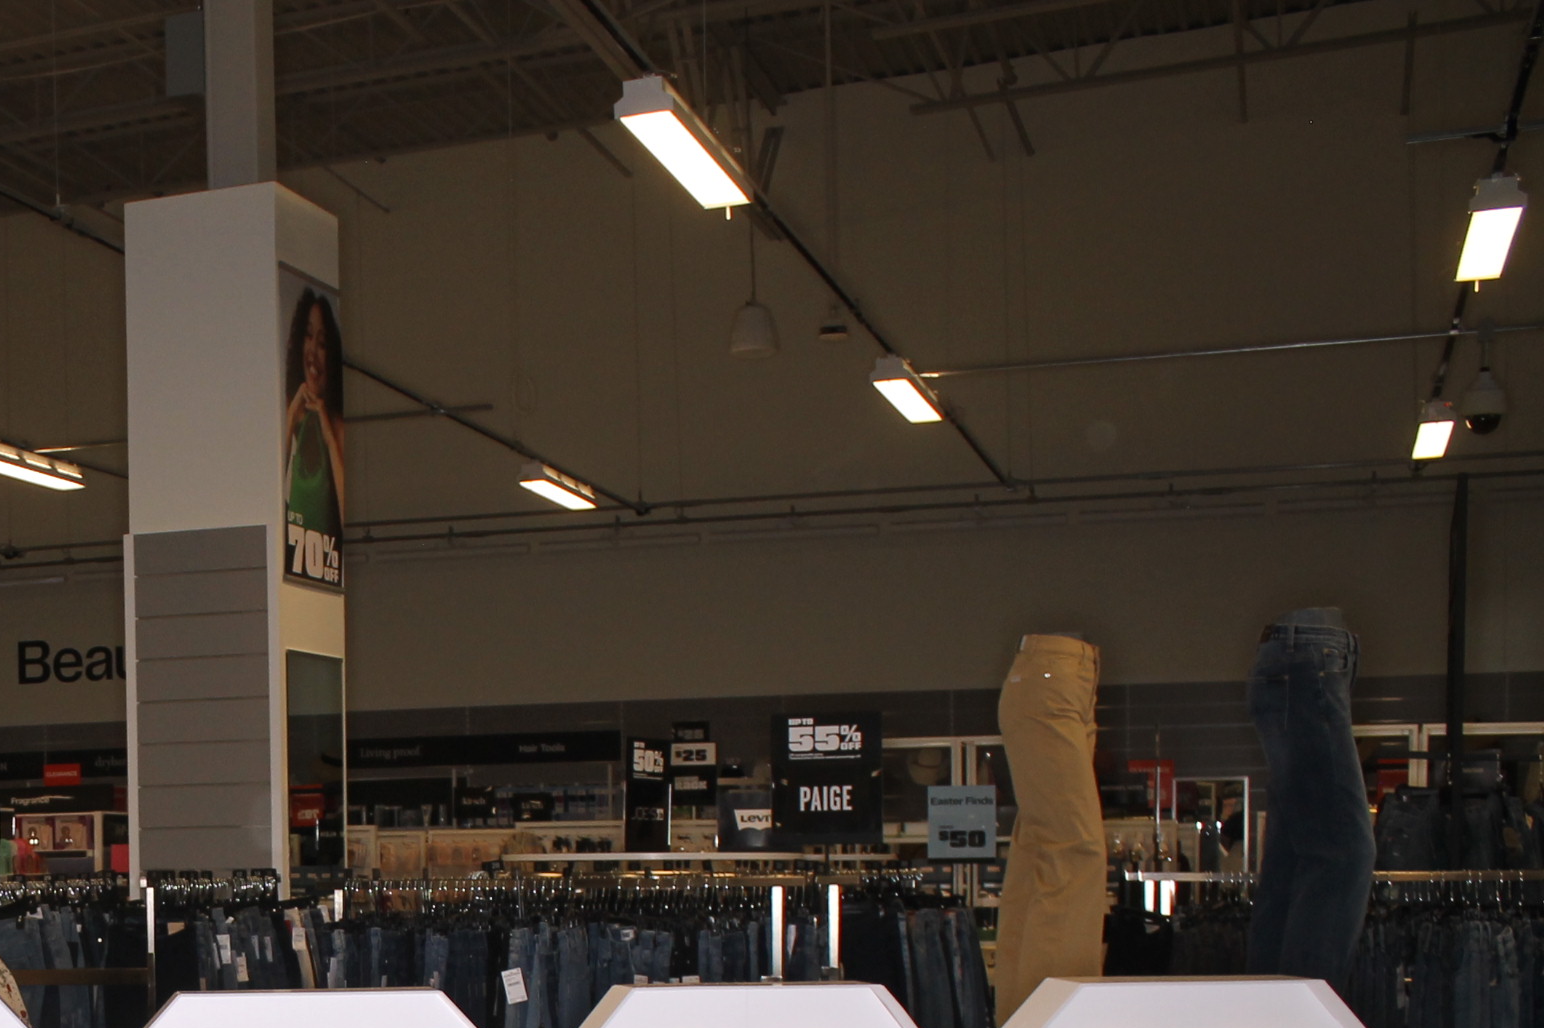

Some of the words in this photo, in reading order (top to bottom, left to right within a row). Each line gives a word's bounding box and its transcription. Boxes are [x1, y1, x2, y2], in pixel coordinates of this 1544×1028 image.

[287, 523, 339, 579] 70%
[323, 565, 339, 583] OFF
[788, 725, 862, 752] 55%
[840, 742, 862, 751] OFF
[799, 785, 853, 812] PAIGE
[938, 830, 986, 848] $50
